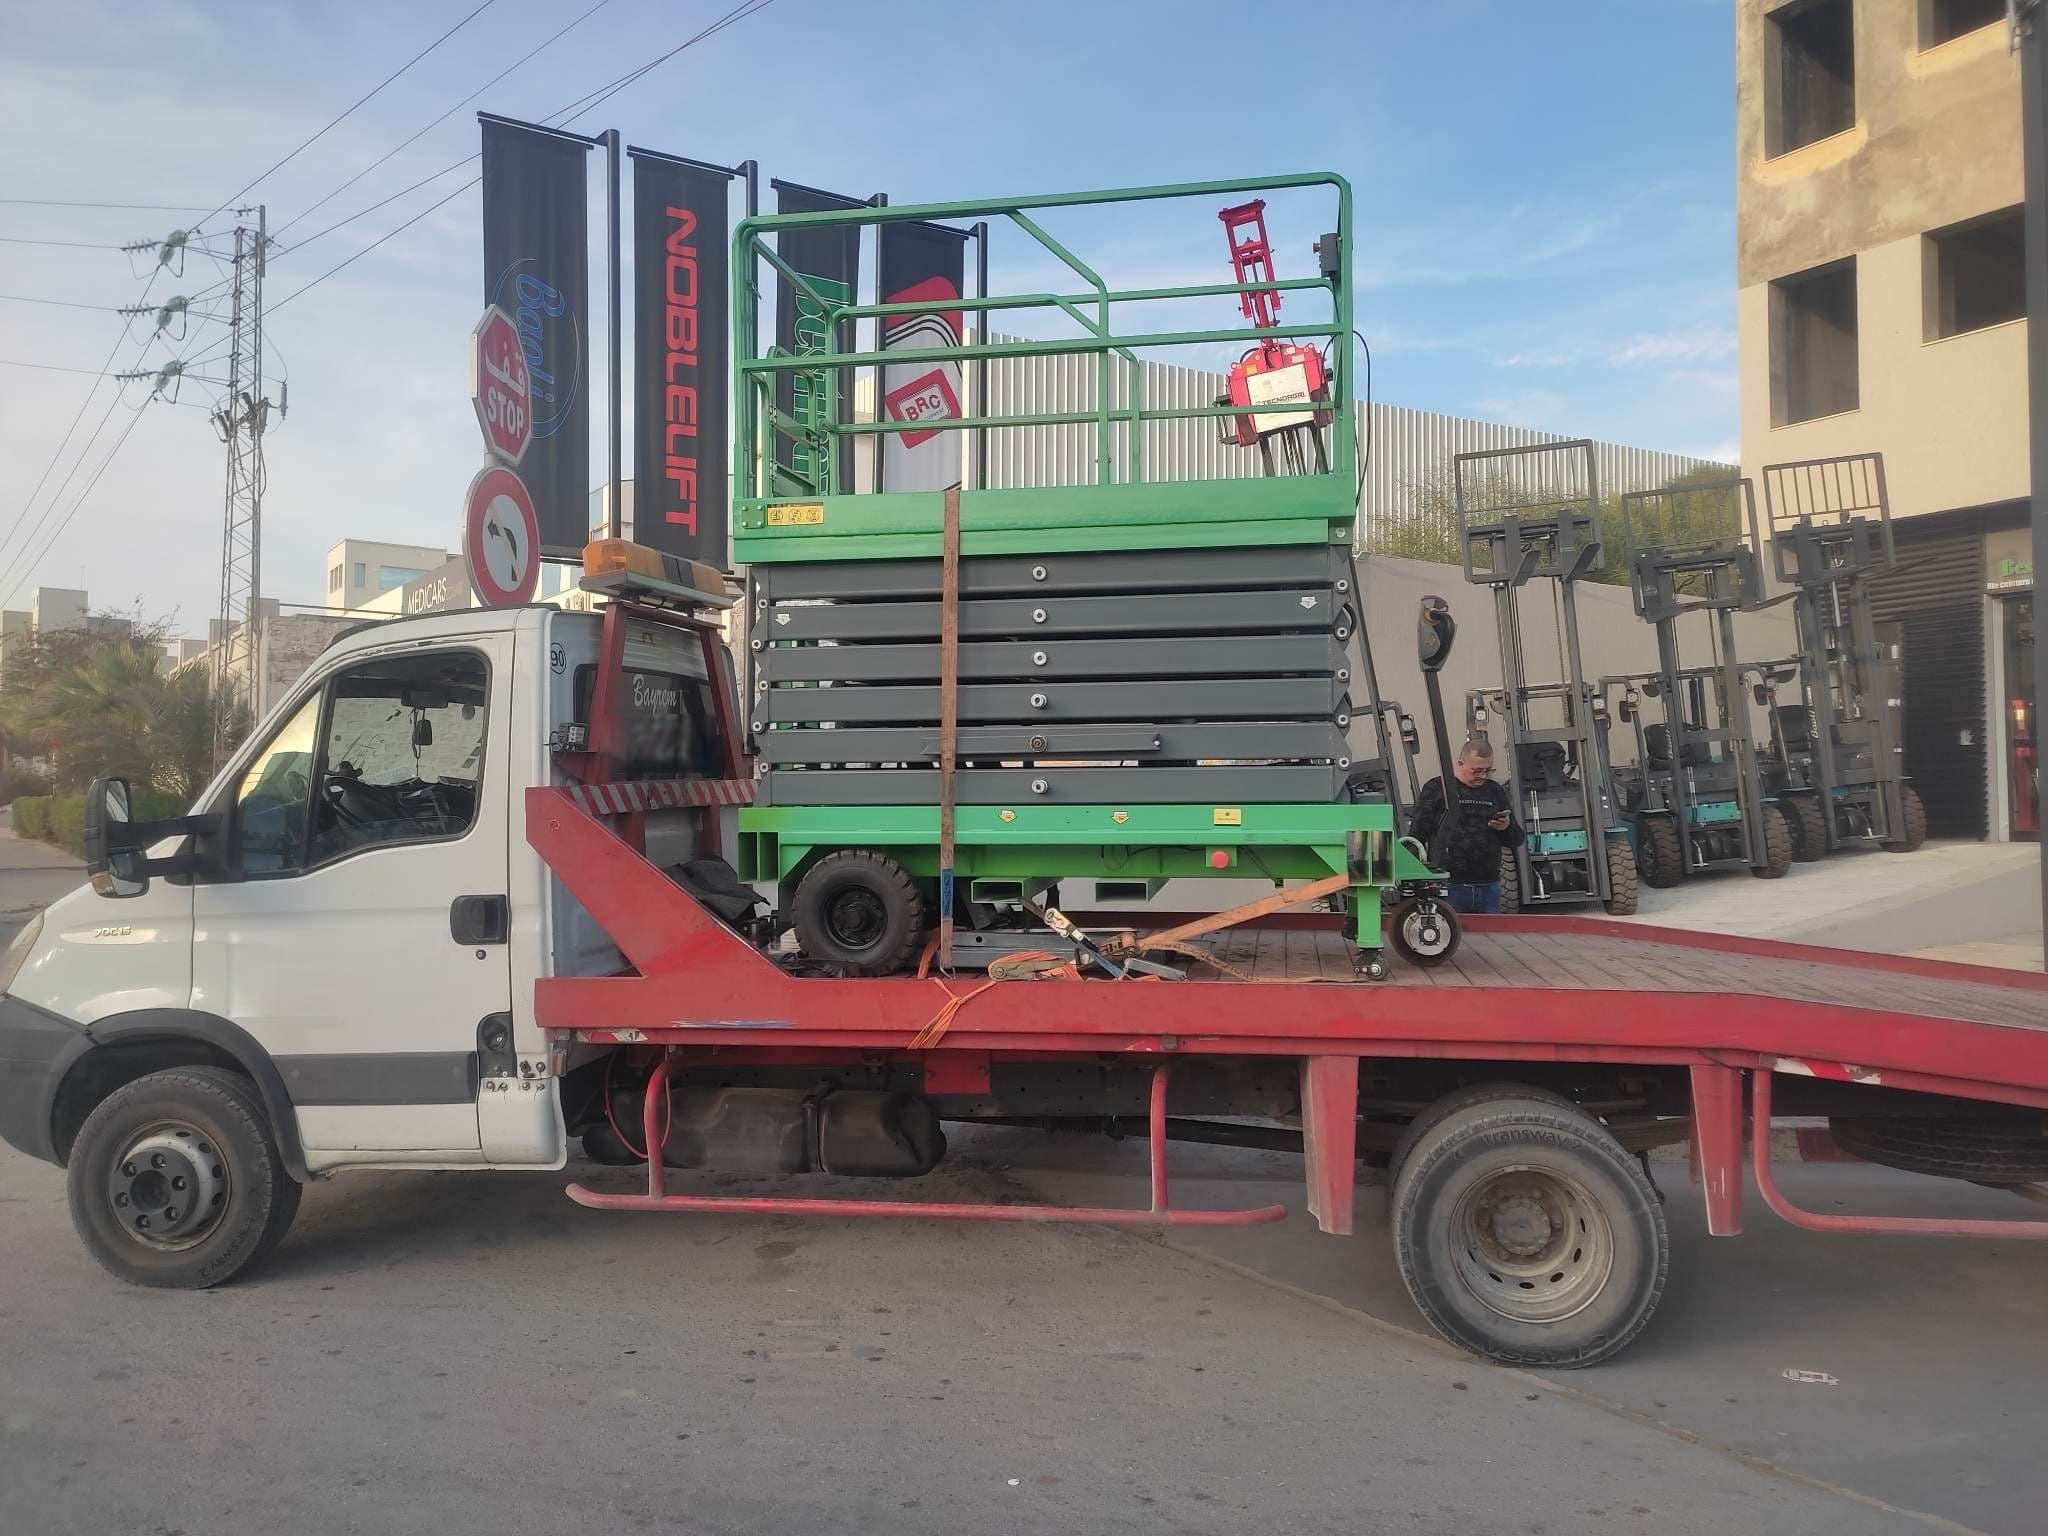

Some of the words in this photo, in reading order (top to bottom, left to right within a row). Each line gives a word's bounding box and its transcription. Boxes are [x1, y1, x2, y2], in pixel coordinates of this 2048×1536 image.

[515, 274, 565, 403] Baoli
[486, 341, 526, 398] قف
[665, 206, 698, 536] NOBLELIFT
[487, 387, 524, 438] STOP
[905, 394, 941, 421] BRC
[407, 576, 447, 614] MEDICARS
[550, 650, 566, 668] 90
